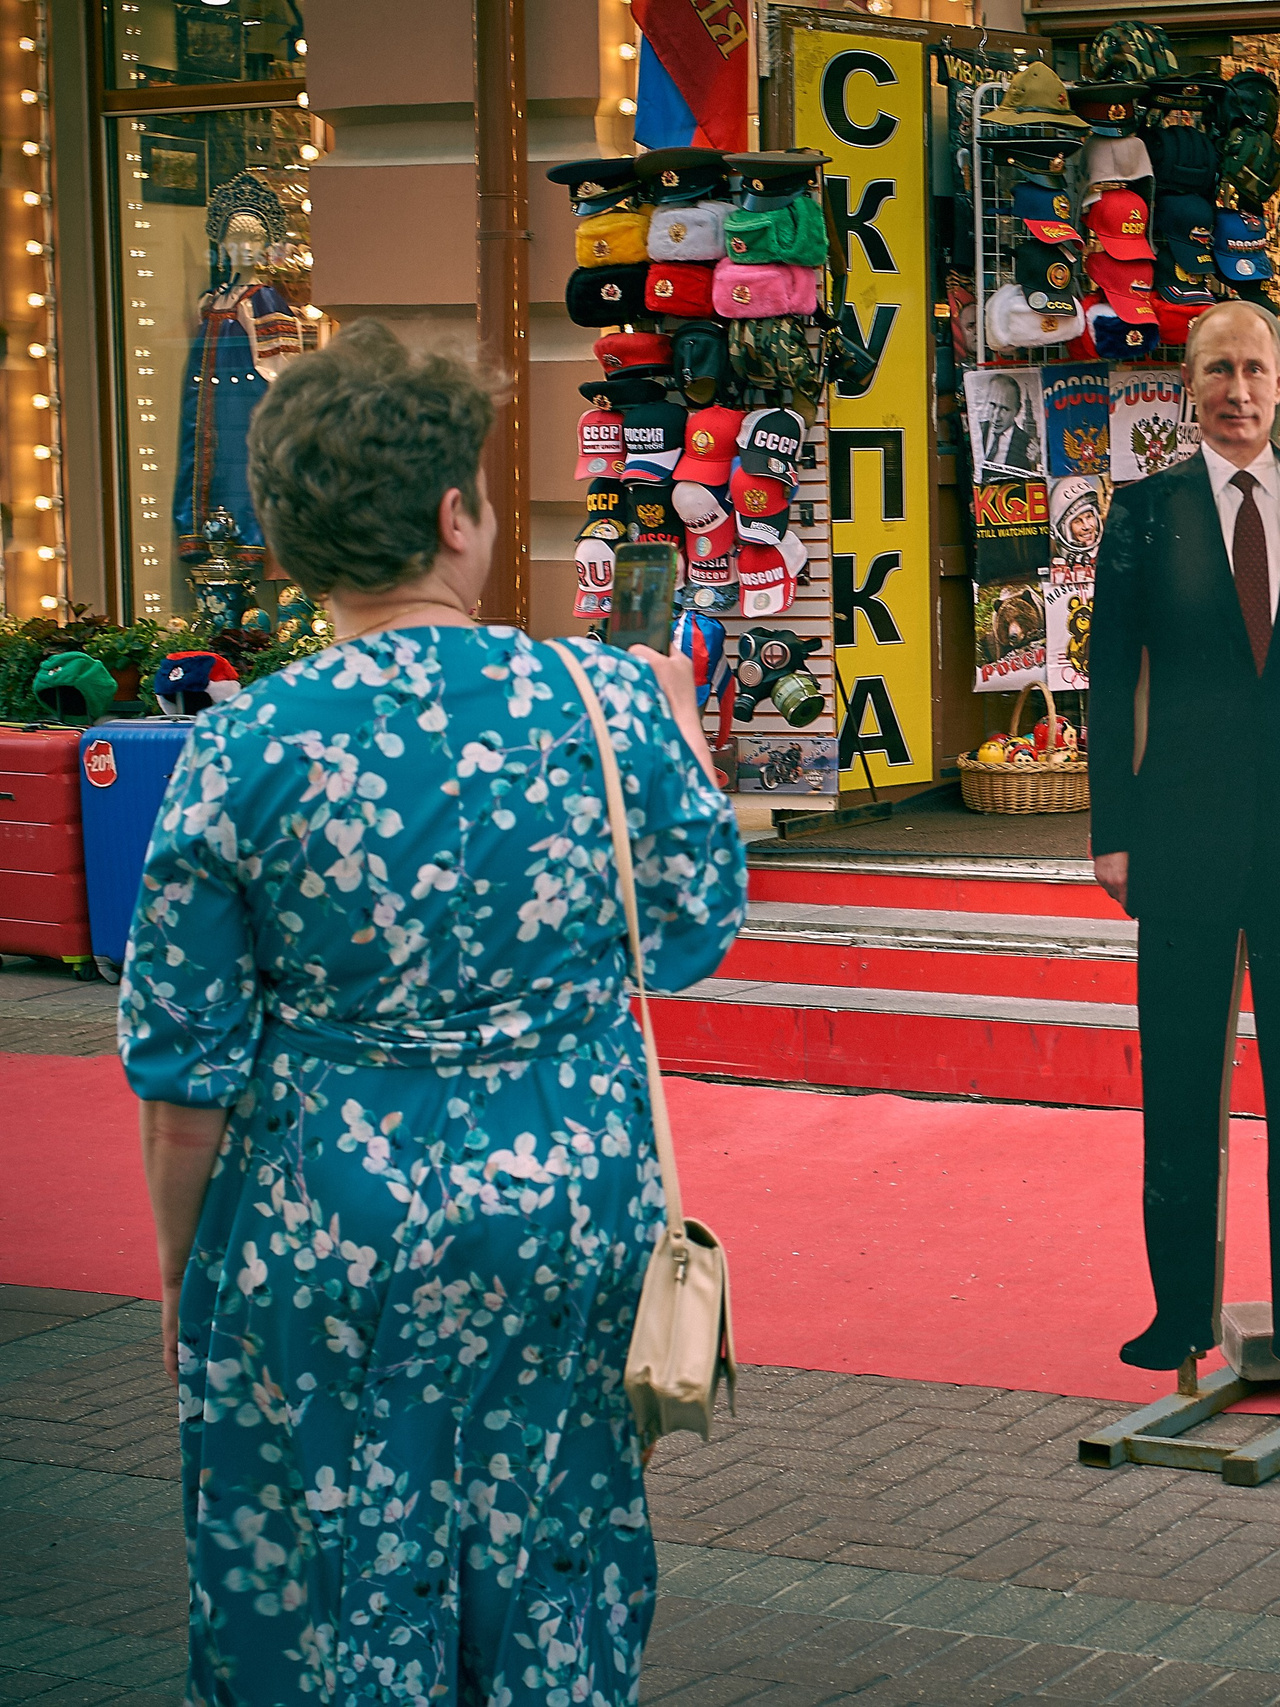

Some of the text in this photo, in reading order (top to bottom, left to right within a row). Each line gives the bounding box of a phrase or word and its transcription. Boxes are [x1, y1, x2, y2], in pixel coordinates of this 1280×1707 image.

[820, 48, 914, 773] СКУПКА
[582, 425, 620, 441] СССР
[753, 429, 799, 456] СССР
[586, 493, 619, 512] СССР
[973, 482, 1050, 527] KGB
